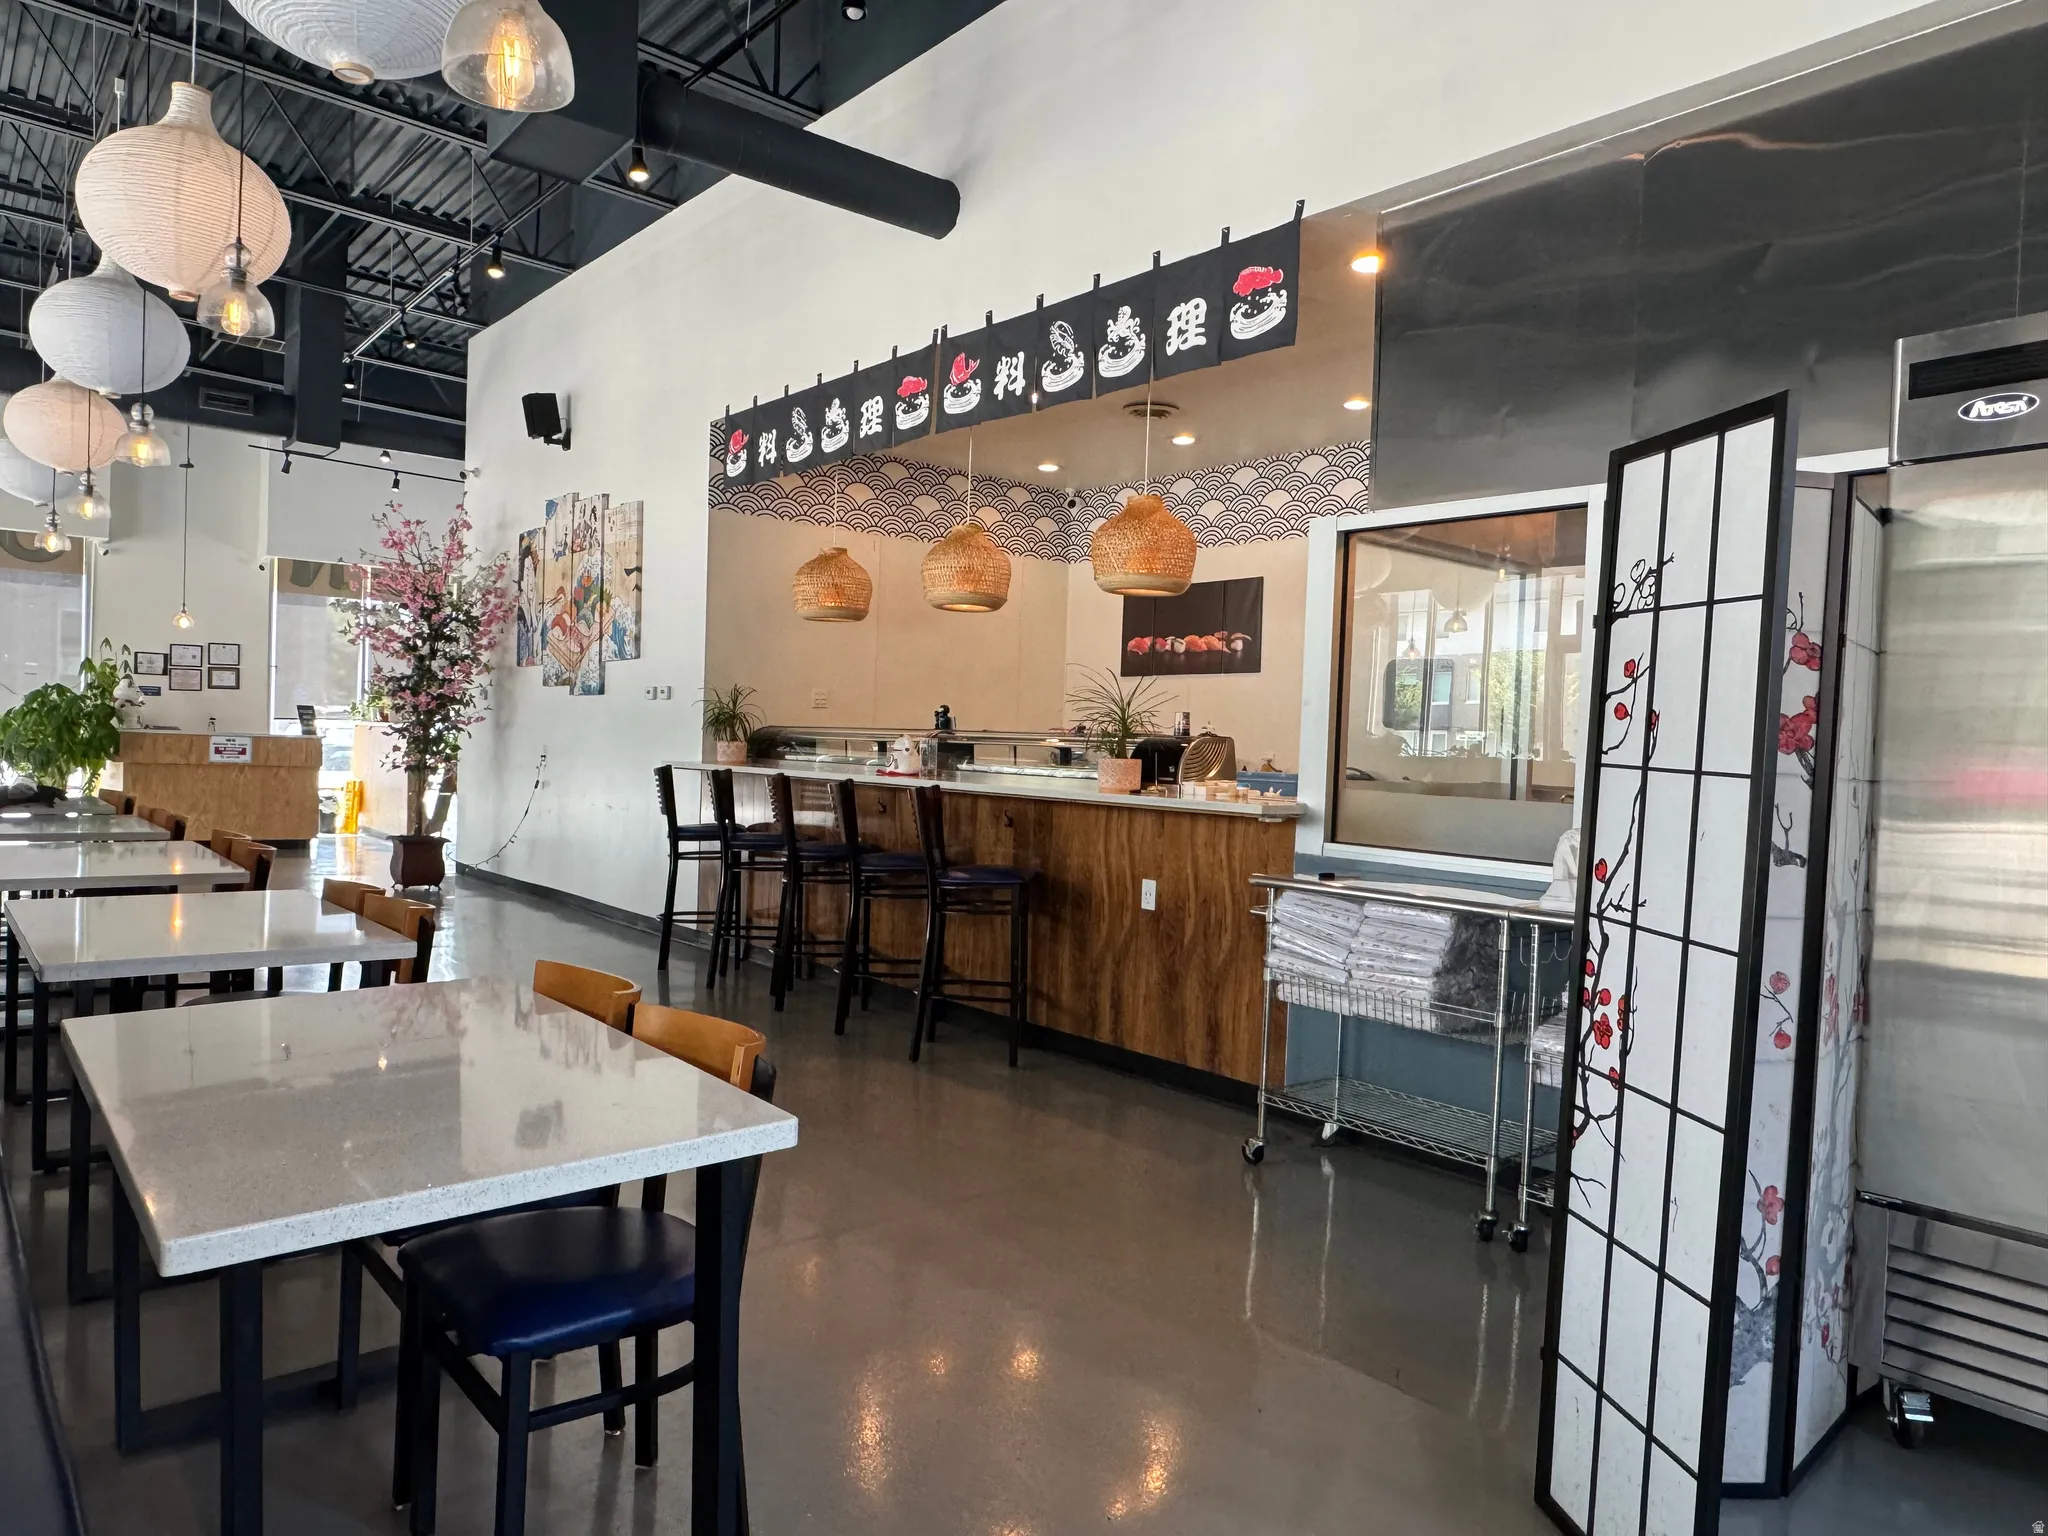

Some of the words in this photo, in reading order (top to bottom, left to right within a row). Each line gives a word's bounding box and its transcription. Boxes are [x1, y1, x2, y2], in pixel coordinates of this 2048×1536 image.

[1165, 297, 1208, 357] 理
[993, 351, 1026, 401] 料
[859, 395, 885, 439] 理
[757, 428, 778, 467] 料
